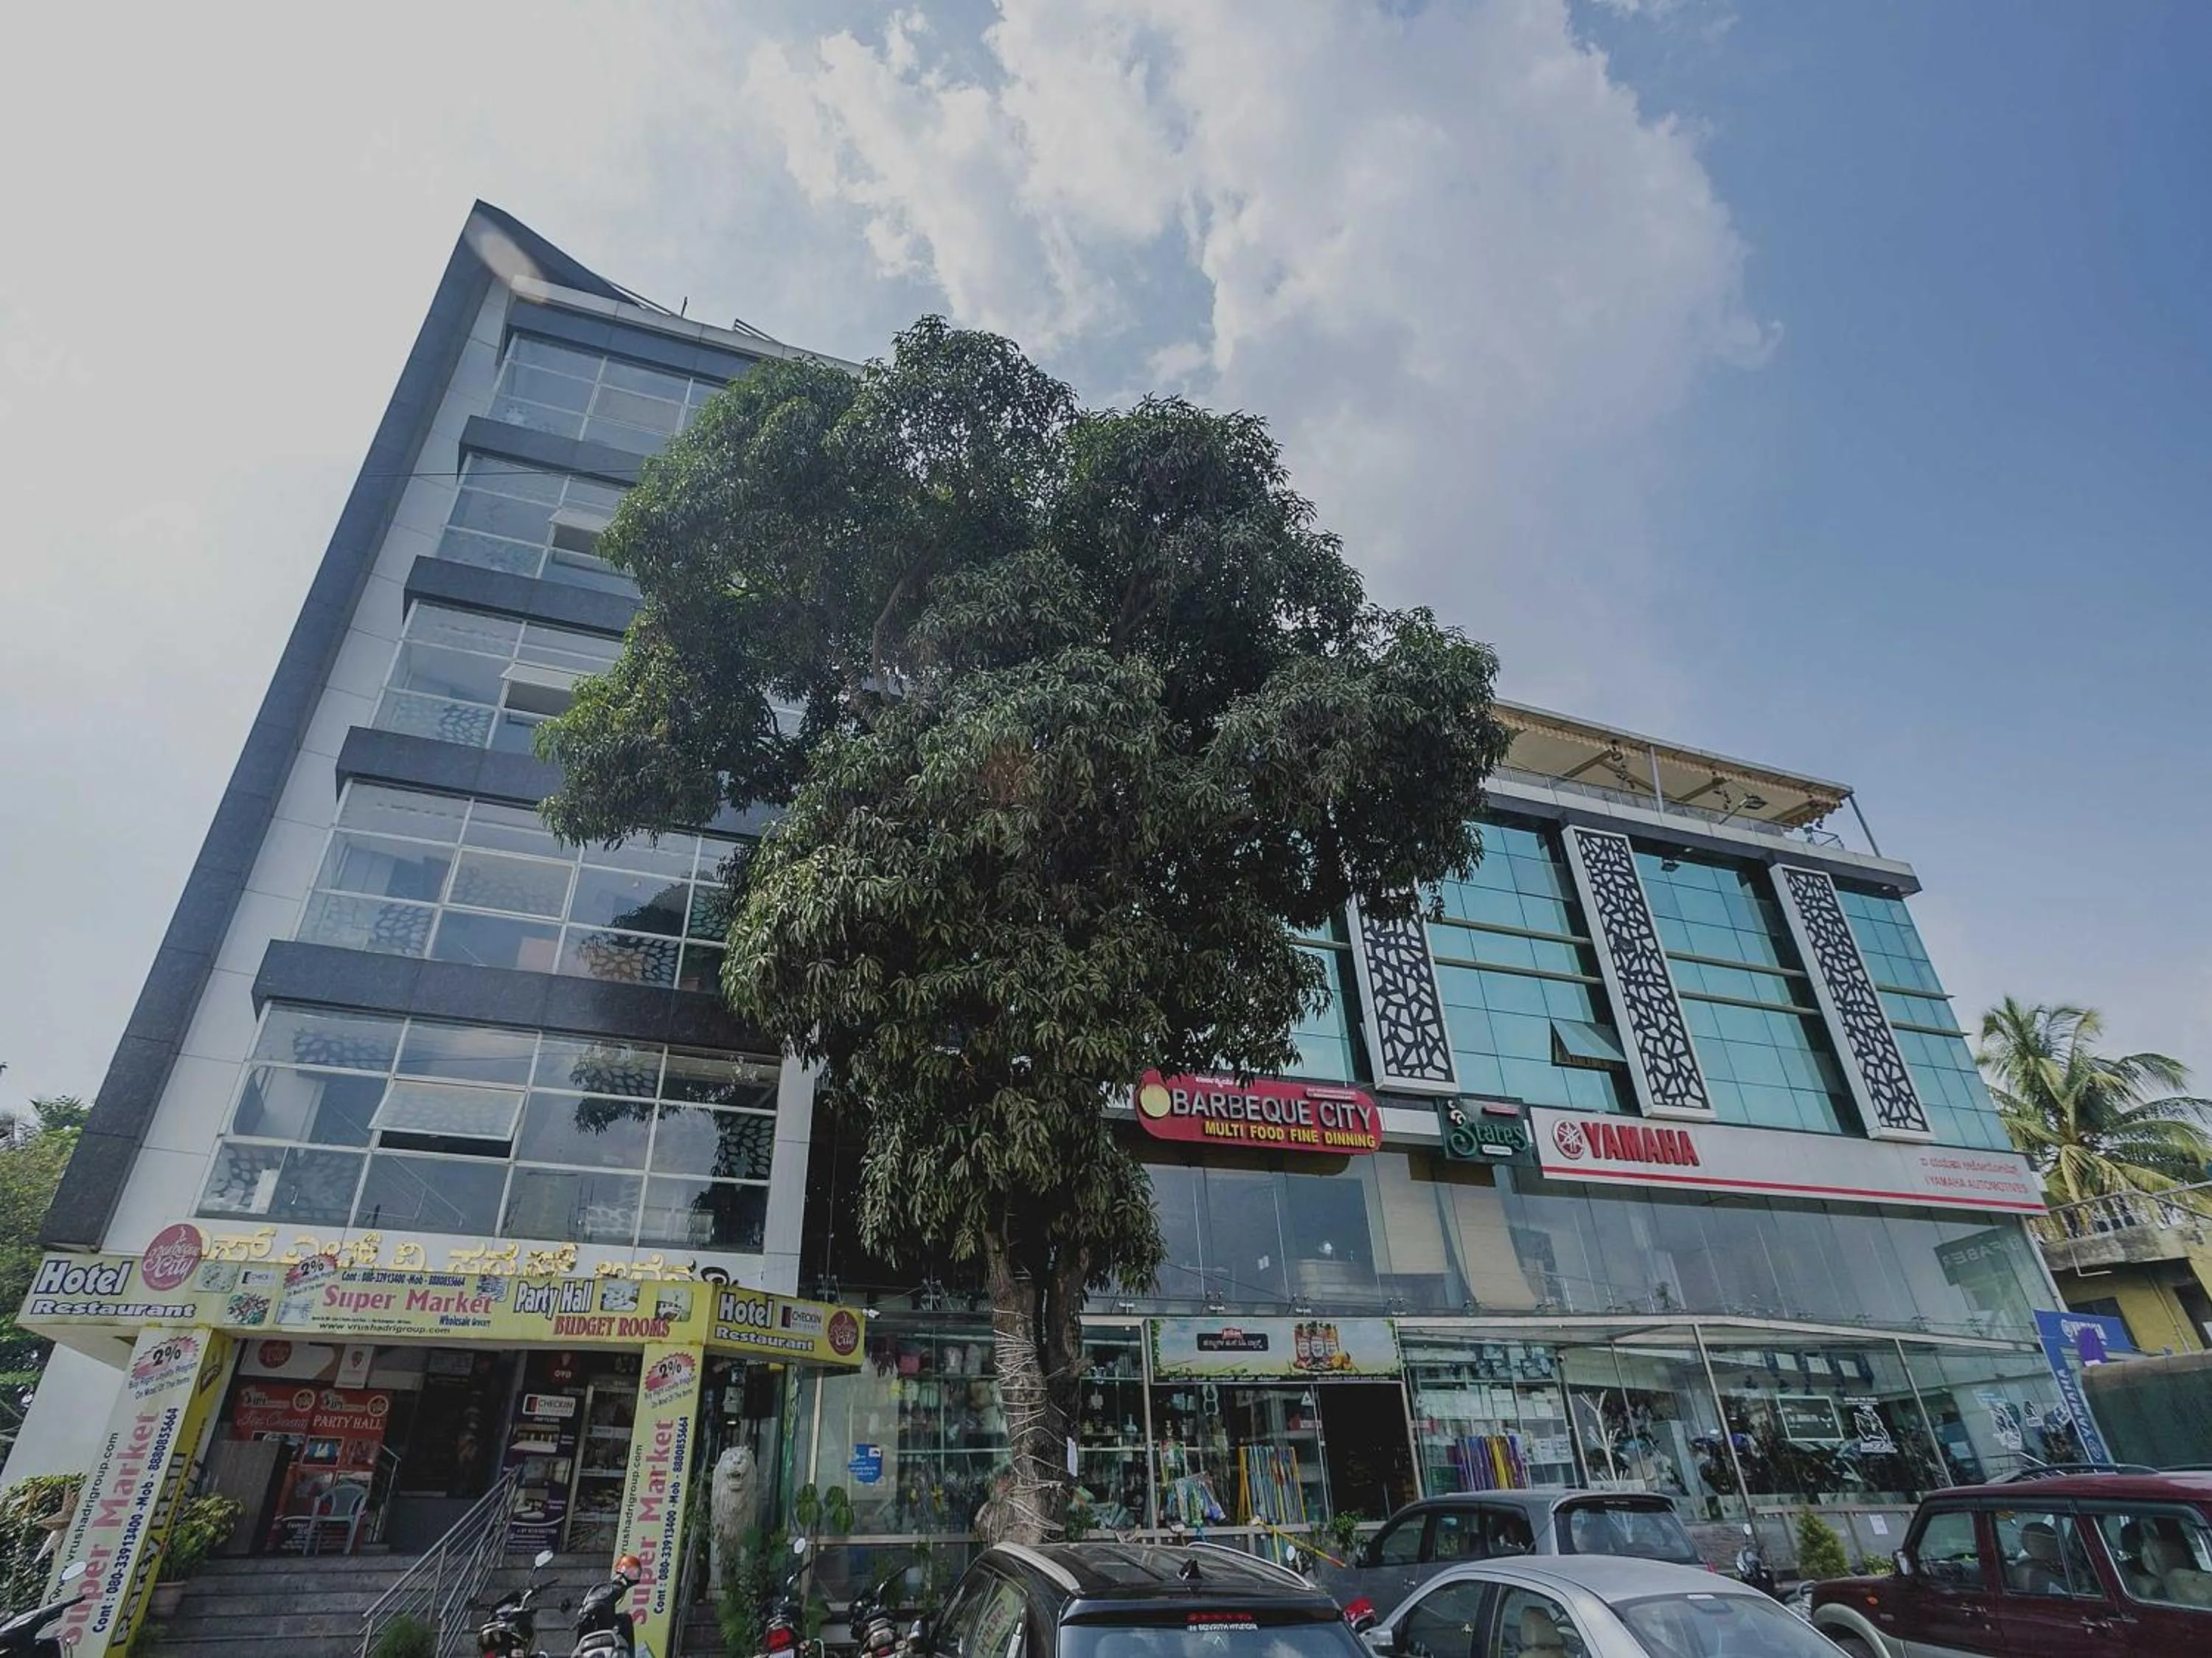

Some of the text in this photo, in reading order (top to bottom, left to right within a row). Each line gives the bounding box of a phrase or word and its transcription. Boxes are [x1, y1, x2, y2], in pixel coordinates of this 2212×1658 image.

[1172, 1089, 1373, 1130] BARBEQUE CITY
[1203, 1120, 1375, 1148] MULTI FOOD FINE DINNING
[1581, 1122, 1700, 1167] YAMAHA
[34, 1260, 133, 1296] Hotel
[300, 1259, 325, 1277] 2%
[30, 1300, 196, 1318] Restaurant
[322, 1284, 492, 1314] Super Market
[514, 1280, 594, 1319] Party Hall
[718, 1291, 775, 1329] Hotel
[554, 1316, 671, 1338] BUDGET ROOMS
[715, 1325, 814, 1352] Restaurant
[153, 1344, 181, 1367] 2%
[659, 1359, 682, 1378] 2%
[2056, 1369, 2092, 1437] YAMAHA
[313, 1415, 383, 1429] PARTY HALL
[48, 1432, 118, 1604] wwvrushadrigroup.com
[61, 1411, 159, 1648] Super Market
[93, 1604, 112, 1633] Cont
[106, 1513, 143, 1595] 080-33913400
[148, 1407, 179, 1471] 8880855664
[630, 1419, 674, 1626] Super Market
[658, 1510, 677, 1581] 080-33913400
[654, 1589, 667, 1615] Cont
